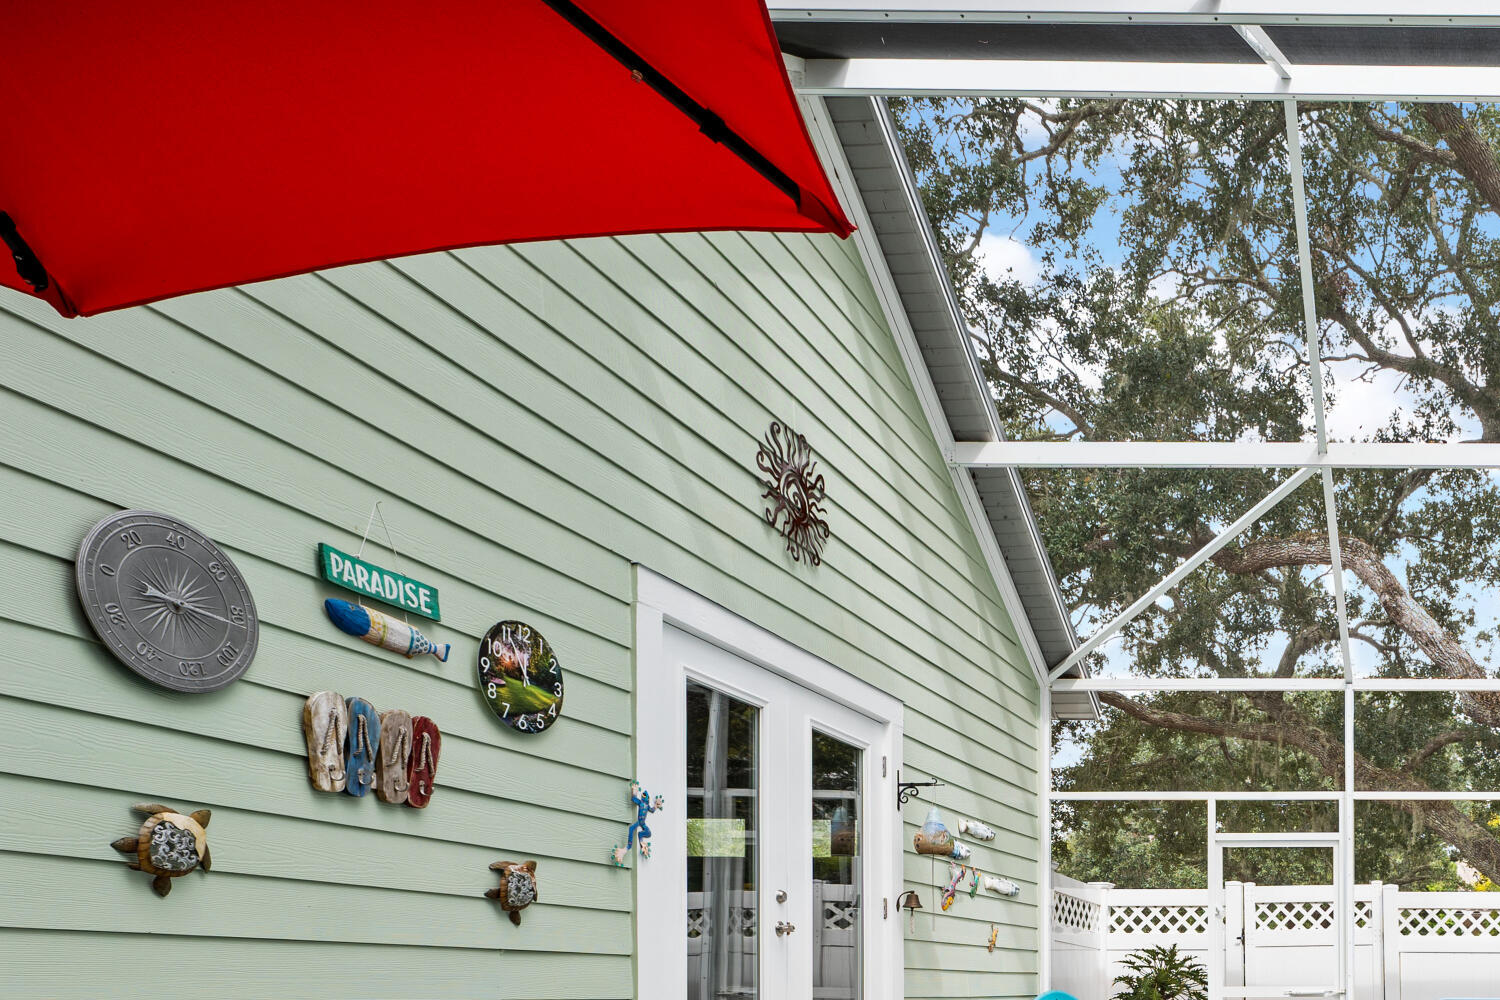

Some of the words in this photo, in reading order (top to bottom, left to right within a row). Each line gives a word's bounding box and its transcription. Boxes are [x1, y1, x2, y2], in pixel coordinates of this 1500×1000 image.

[120, 529, 143, 549] 20
[165, 531, 186, 550] 40
[100, 563, 116, 577] 0
[208, 561, 227, 582] 60
[330, 552, 432, 614] PARADISE
[230, 605, 245, 625] 80
[502, 625, 511, 642] 11
[518, 624, 531, 643] 12
[217, 641, 240, 666] 100
[488, 638, 502, 657] 10
[178, 661, 208, 676] 120
[480, 657, 490, 673] 9
[549, 658, 557, 674] 2
[487, 682, 497, 699] 8
[554, 682, 562, 698] 3
[502, 702, 511, 718] 7
[548, 703, 557, 718] 4
[518, 714, 528, 729] 6
[536, 714, 545, 729] 5
